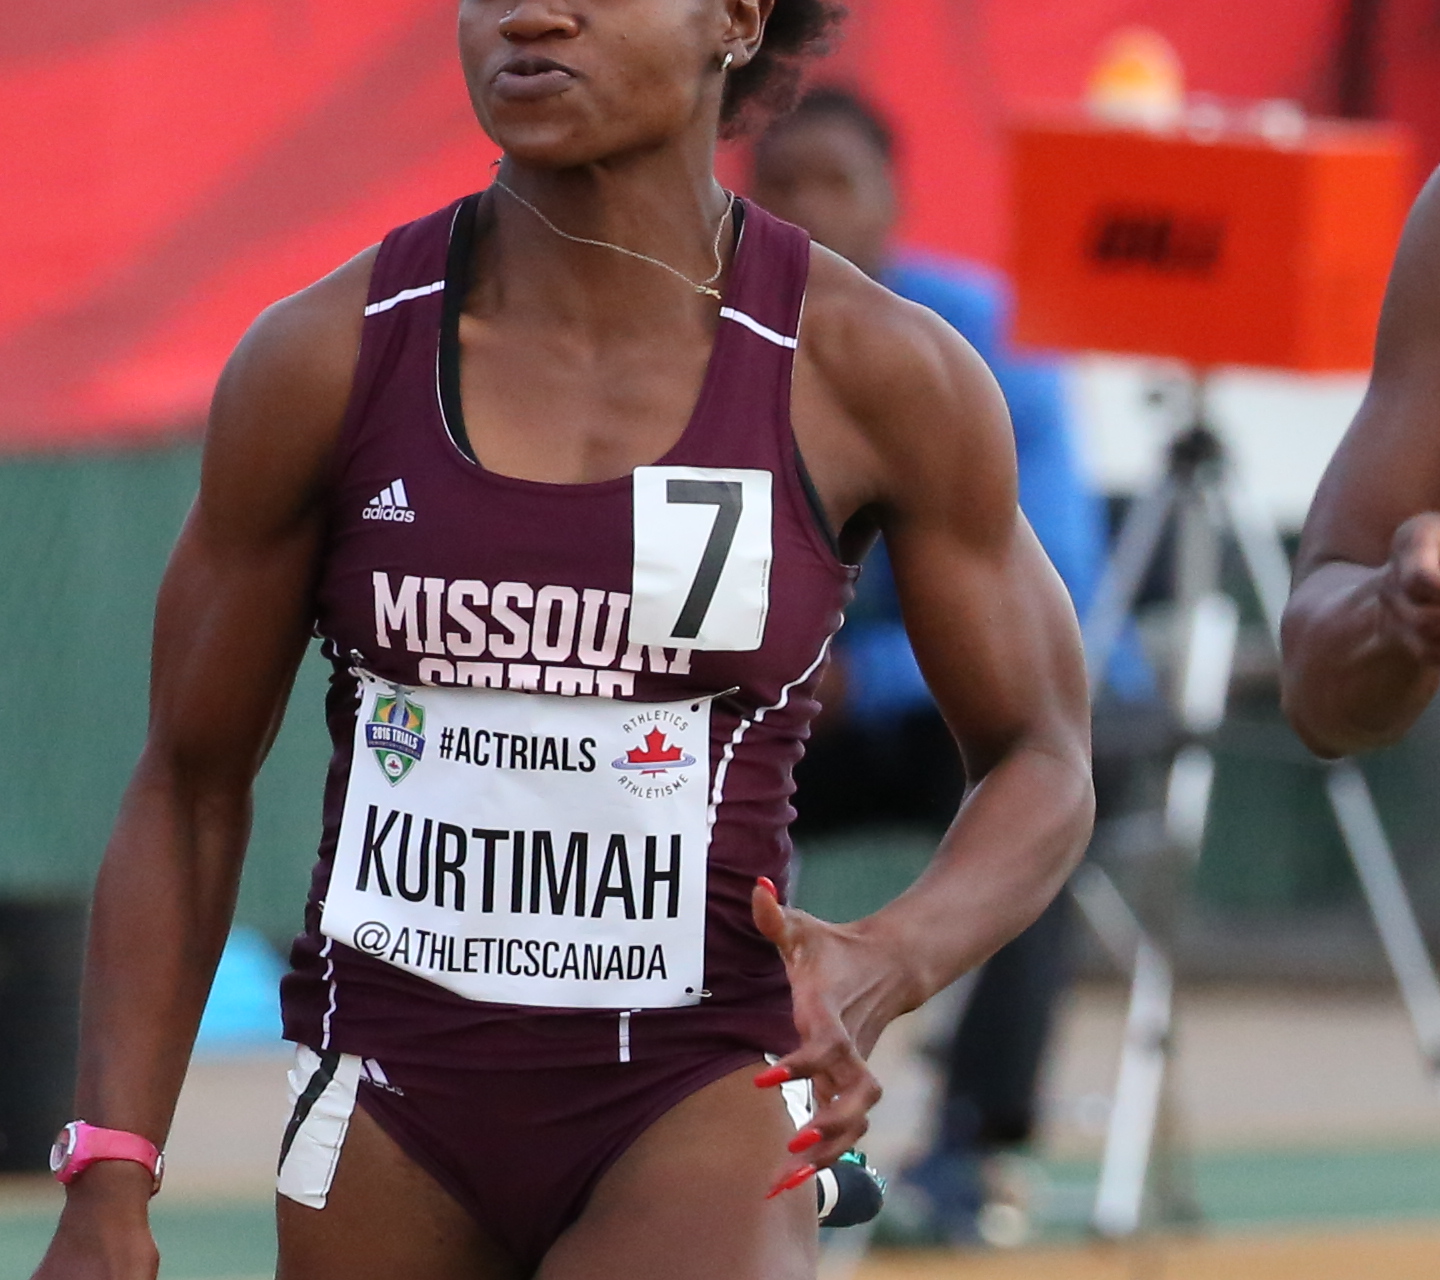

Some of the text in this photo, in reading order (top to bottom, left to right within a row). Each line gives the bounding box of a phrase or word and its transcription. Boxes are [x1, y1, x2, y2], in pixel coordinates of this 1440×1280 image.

[362, 504, 415, 523] adidas
[666, 479, 742, 639] 7
[372, 726, 391, 741] 2016
[392, 728, 419, 750] TRIALS
[622, 709, 689, 734] ATHLETICS
[440, 726, 597, 773] #ACTRIALS
[618, 773, 689, 799] ATHLÉTISME
[355, 805, 683, 920] KURTIMAH
[353, 922, 668, 982] @ATHLETICSCANADA
